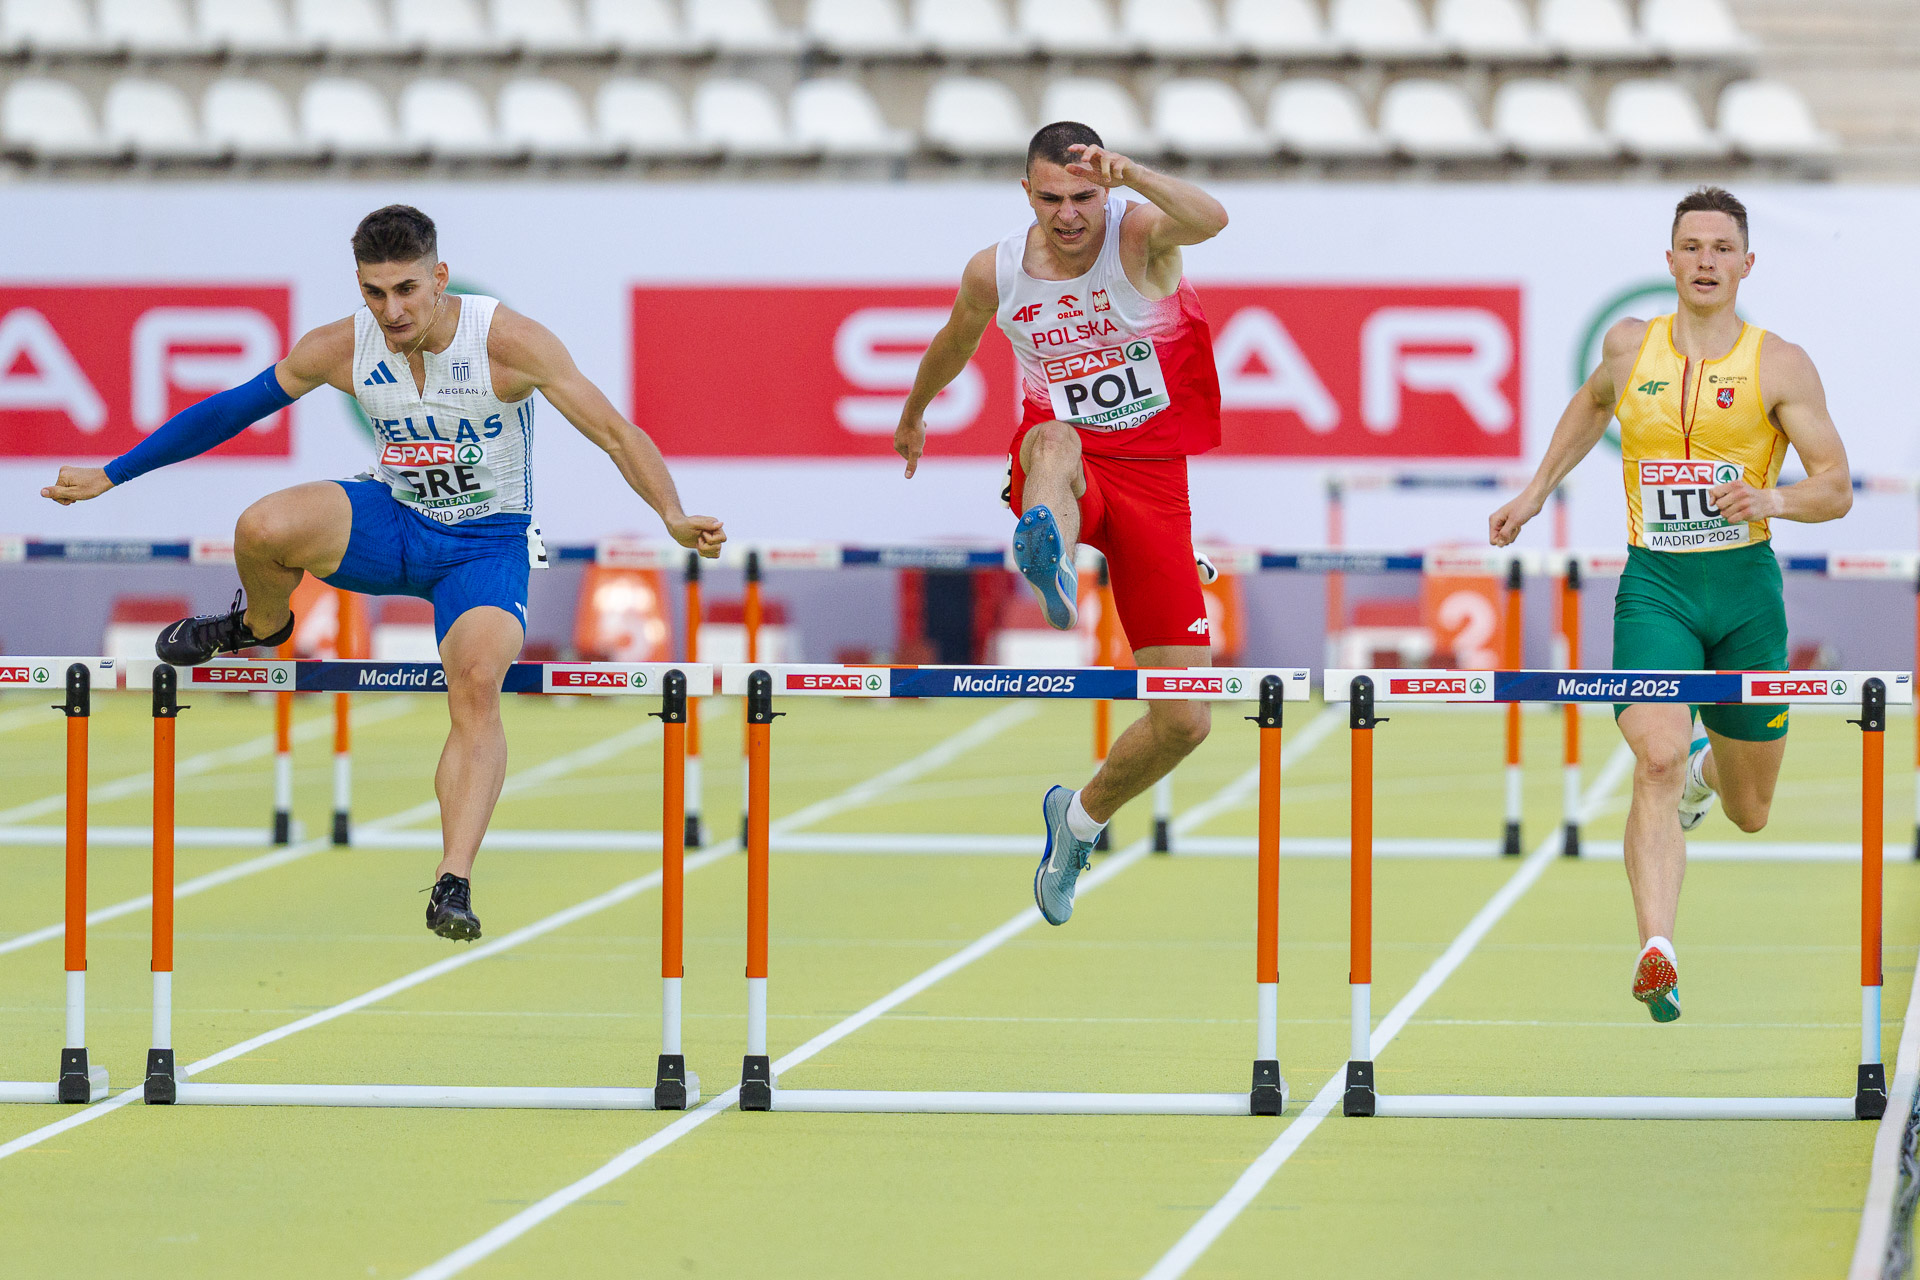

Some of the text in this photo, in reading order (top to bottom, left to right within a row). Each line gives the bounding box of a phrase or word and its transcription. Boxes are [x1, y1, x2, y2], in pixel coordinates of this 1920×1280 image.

[1012, 303, 1043, 323] 4F
[1058, 310, 1084, 320] ORLEN
[1031, 318, 1119, 349] POLSKA
[832, 305, 1514, 435] SAR
[1046, 349, 1123, 380] SPAR
[1064, 367, 1152, 416] POL
[1637, 380, 1670, 395] 4F
[1085, 414, 1109, 424] RUN
[1109, 402, 1143, 419] CLEAN
[384, 446, 454, 463] SPAR
[398, 466, 481, 498] GRE
[1643, 465, 1712, 483] SPAR
[436, 495, 471, 508] CLEAN
[1657, 489, 1723, 520] LTU
[409, 502, 490, 523] ADRID 2025
[1667, 523, 1688, 531] RUN
[1689, 520, 1722, 530] CLEAN
[1652, 529, 1740, 546] MADRID 2025
[209, 669, 267, 681] SPAR
[358, 669, 427, 686] Madrid
[569, 673, 627, 685] SPAR
[803, 676, 862, 688] SPAR
[953, 675, 1076, 692] Madrid 2025
[1163, 679, 1222, 691] SPAR
[1407, 680, 1465, 692] SPAR
[1557, 678, 1680, 697] Madrid 2025
[1768, 682, 1827, 694] SPAR
